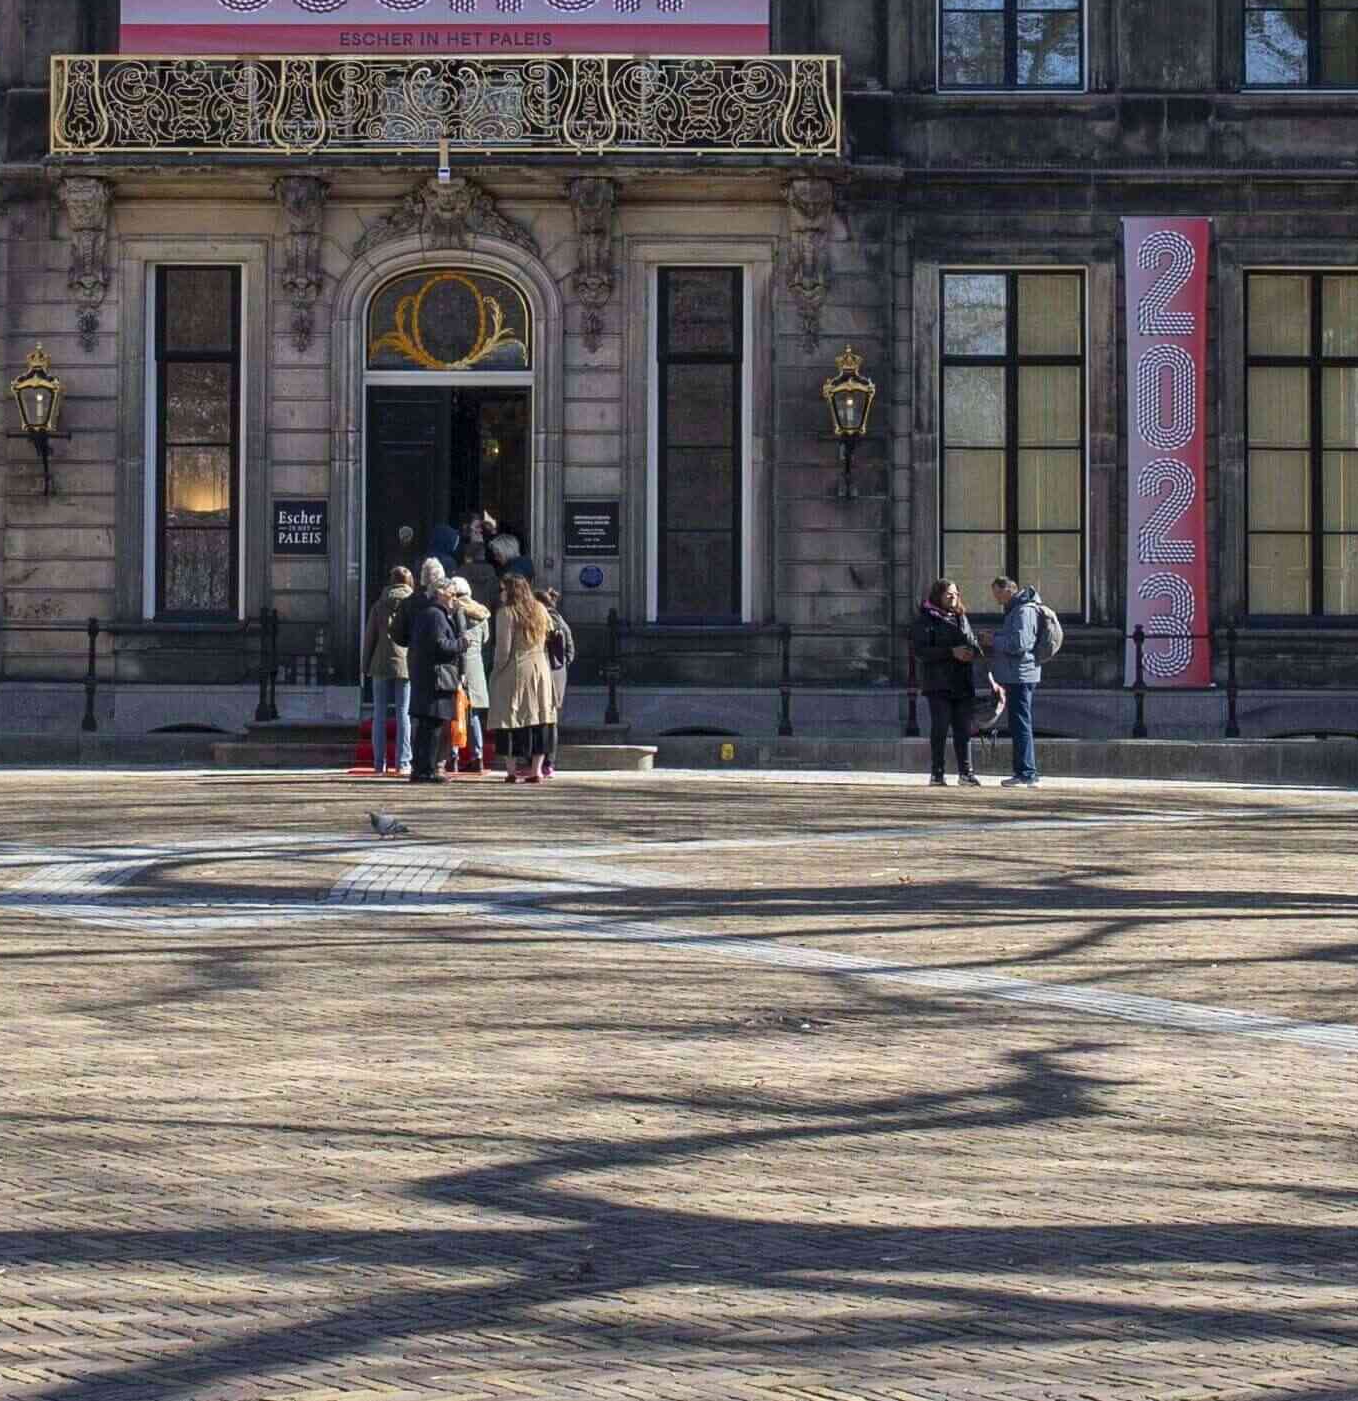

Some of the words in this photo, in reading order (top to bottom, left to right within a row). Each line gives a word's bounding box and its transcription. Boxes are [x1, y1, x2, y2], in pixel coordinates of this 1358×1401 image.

[339, 31, 413, 46] ESCHER
[420, 31, 439, 46] IN
[447, 31, 483, 46] HET
[490, 31, 553, 46] PALEIS
[1137, 230, 1196, 678] 2023
[277, 509, 324, 525] Escher
[278, 531, 323, 545] PALEIS
